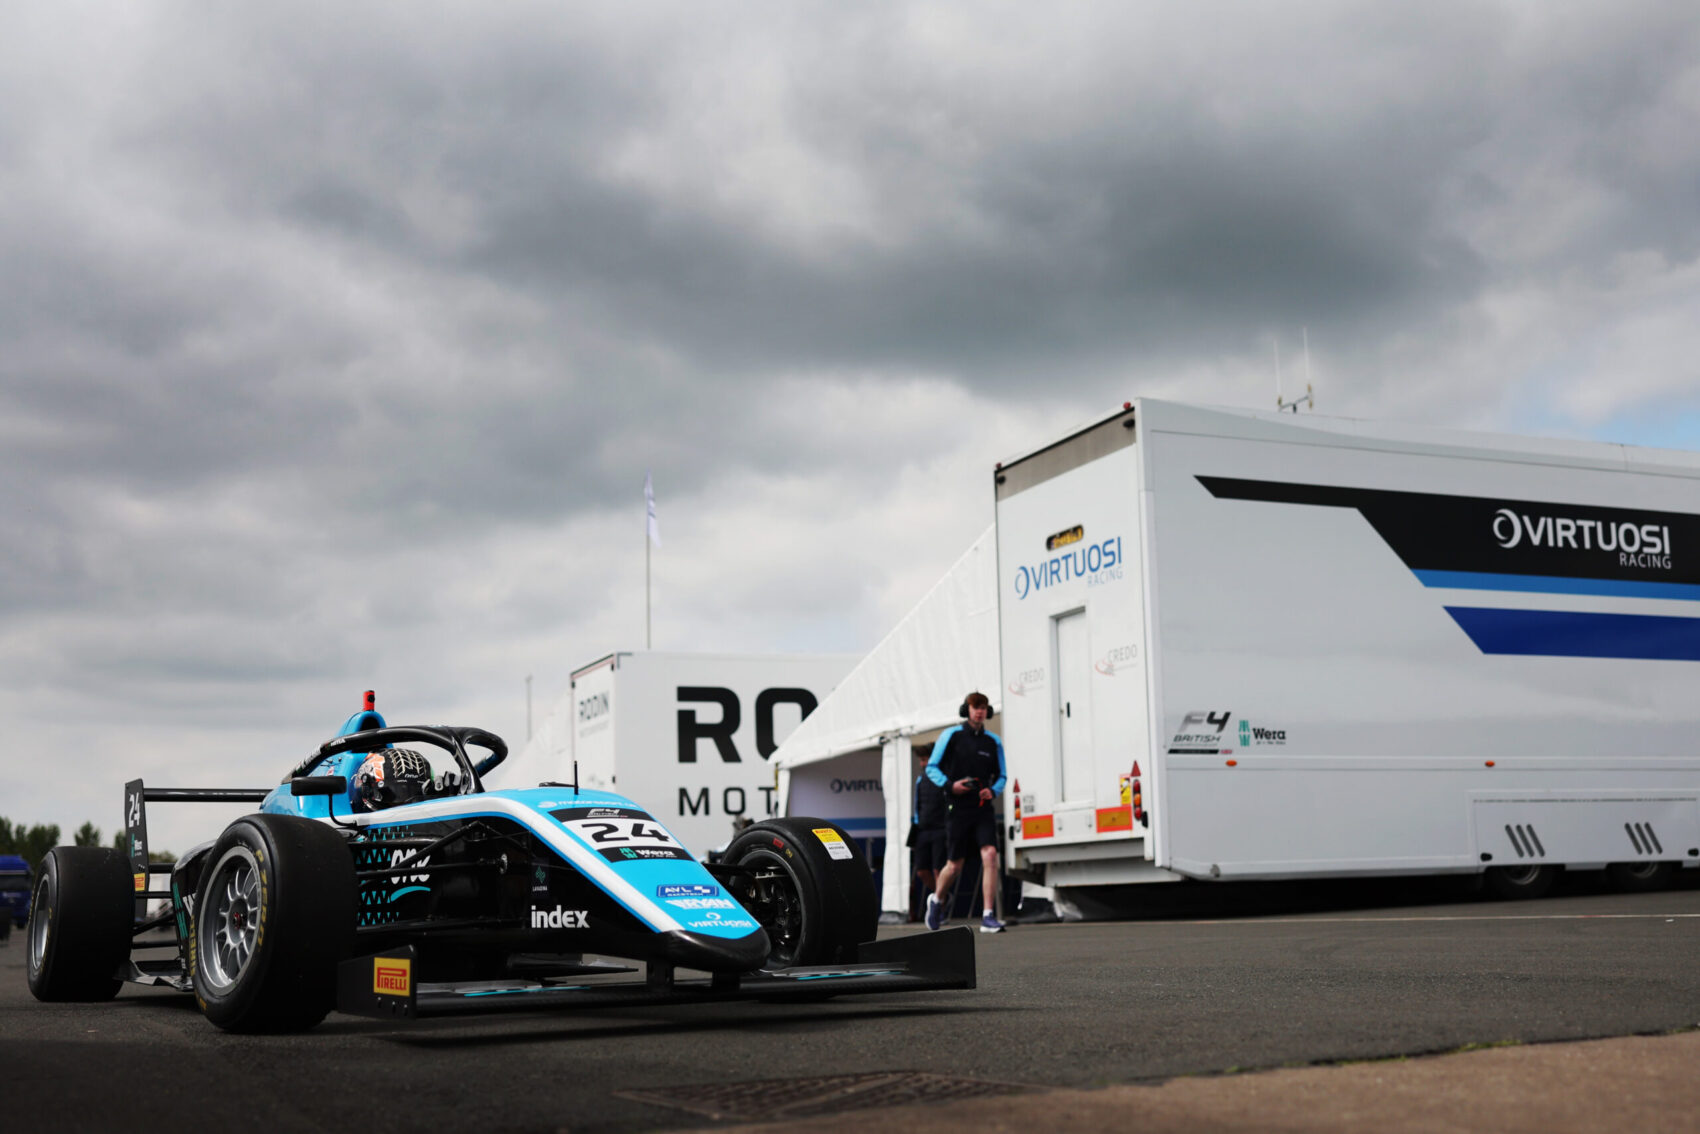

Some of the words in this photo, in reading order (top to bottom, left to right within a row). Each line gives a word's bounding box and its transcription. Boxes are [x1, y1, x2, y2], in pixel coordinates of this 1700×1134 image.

[1522, 514, 1672, 555] VIRTUOSI
[1030, 535, 1122, 591] VIRTUOSI
[1619, 552, 1672, 570] RACING
[1086, 568, 1123, 589] RACING
[1108, 644, 1138, 663] CREDO
[1019, 667, 1045, 684] CREDO
[676, 686, 819, 763] RO
[1178, 711, 1232, 733] F4
[1172, 734, 1222, 743] BRITISH
[1252, 728, 1287, 740] Wera
[128, 791, 141, 828] 24
[678, 787, 778, 816] MOT
[581, 822, 670, 843] 24
[634, 849, 675, 857] Wera
[531, 904, 590, 929] index
[688, 920, 755, 928] VIRTUOSI
[376, 966, 408, 991] PIRELLI
